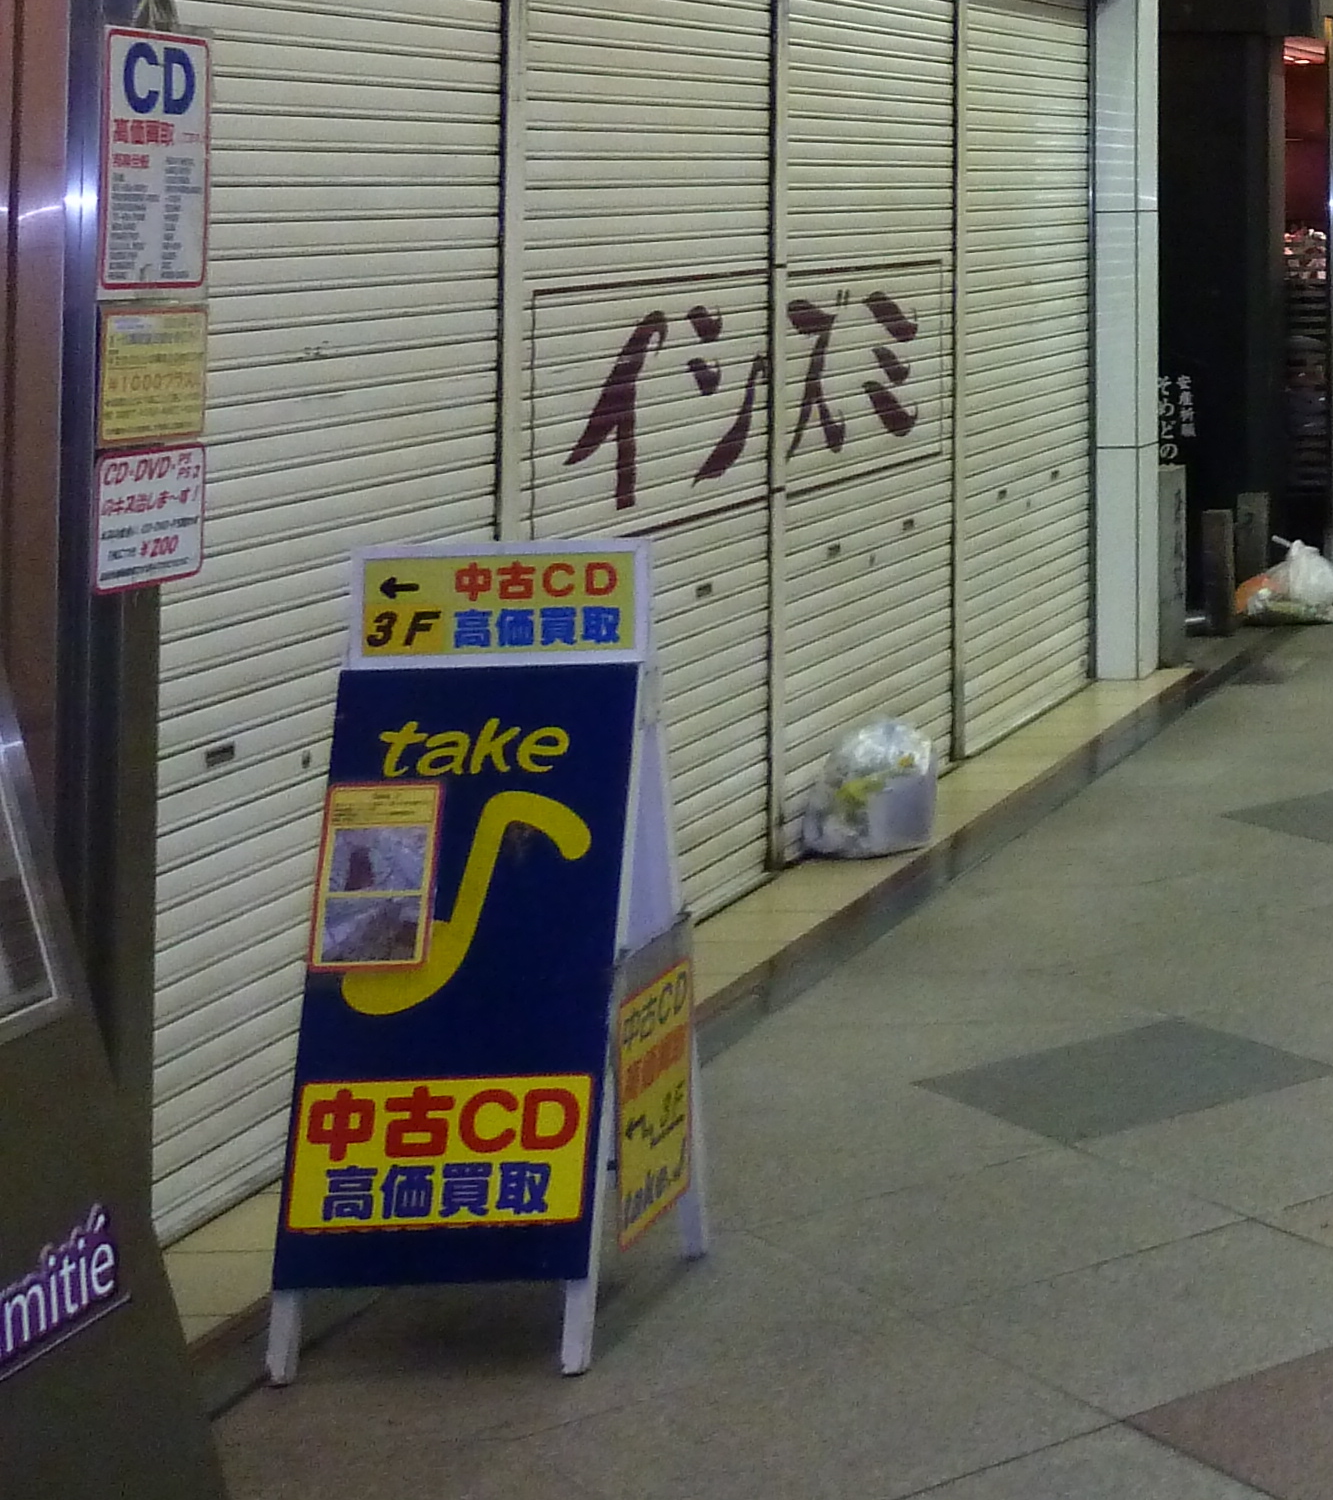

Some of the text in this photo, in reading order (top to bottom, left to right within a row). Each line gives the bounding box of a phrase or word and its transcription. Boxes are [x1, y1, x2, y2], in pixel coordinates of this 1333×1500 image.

[123, 41, 196, 116] CD
[563, 288, 920, 511] イシズミ
[453, 561, 618, 601] 中古CD
[366, 610, 441, 649] 3F
[453, 604, 621, 650] 高価買取
[378, 717, 570, 779] take
[306, 1086, 581, 1161] 中古CD
[321, 1160, 552, 1222] 高価買取
[0, 1212, 116, 1355] mitié
